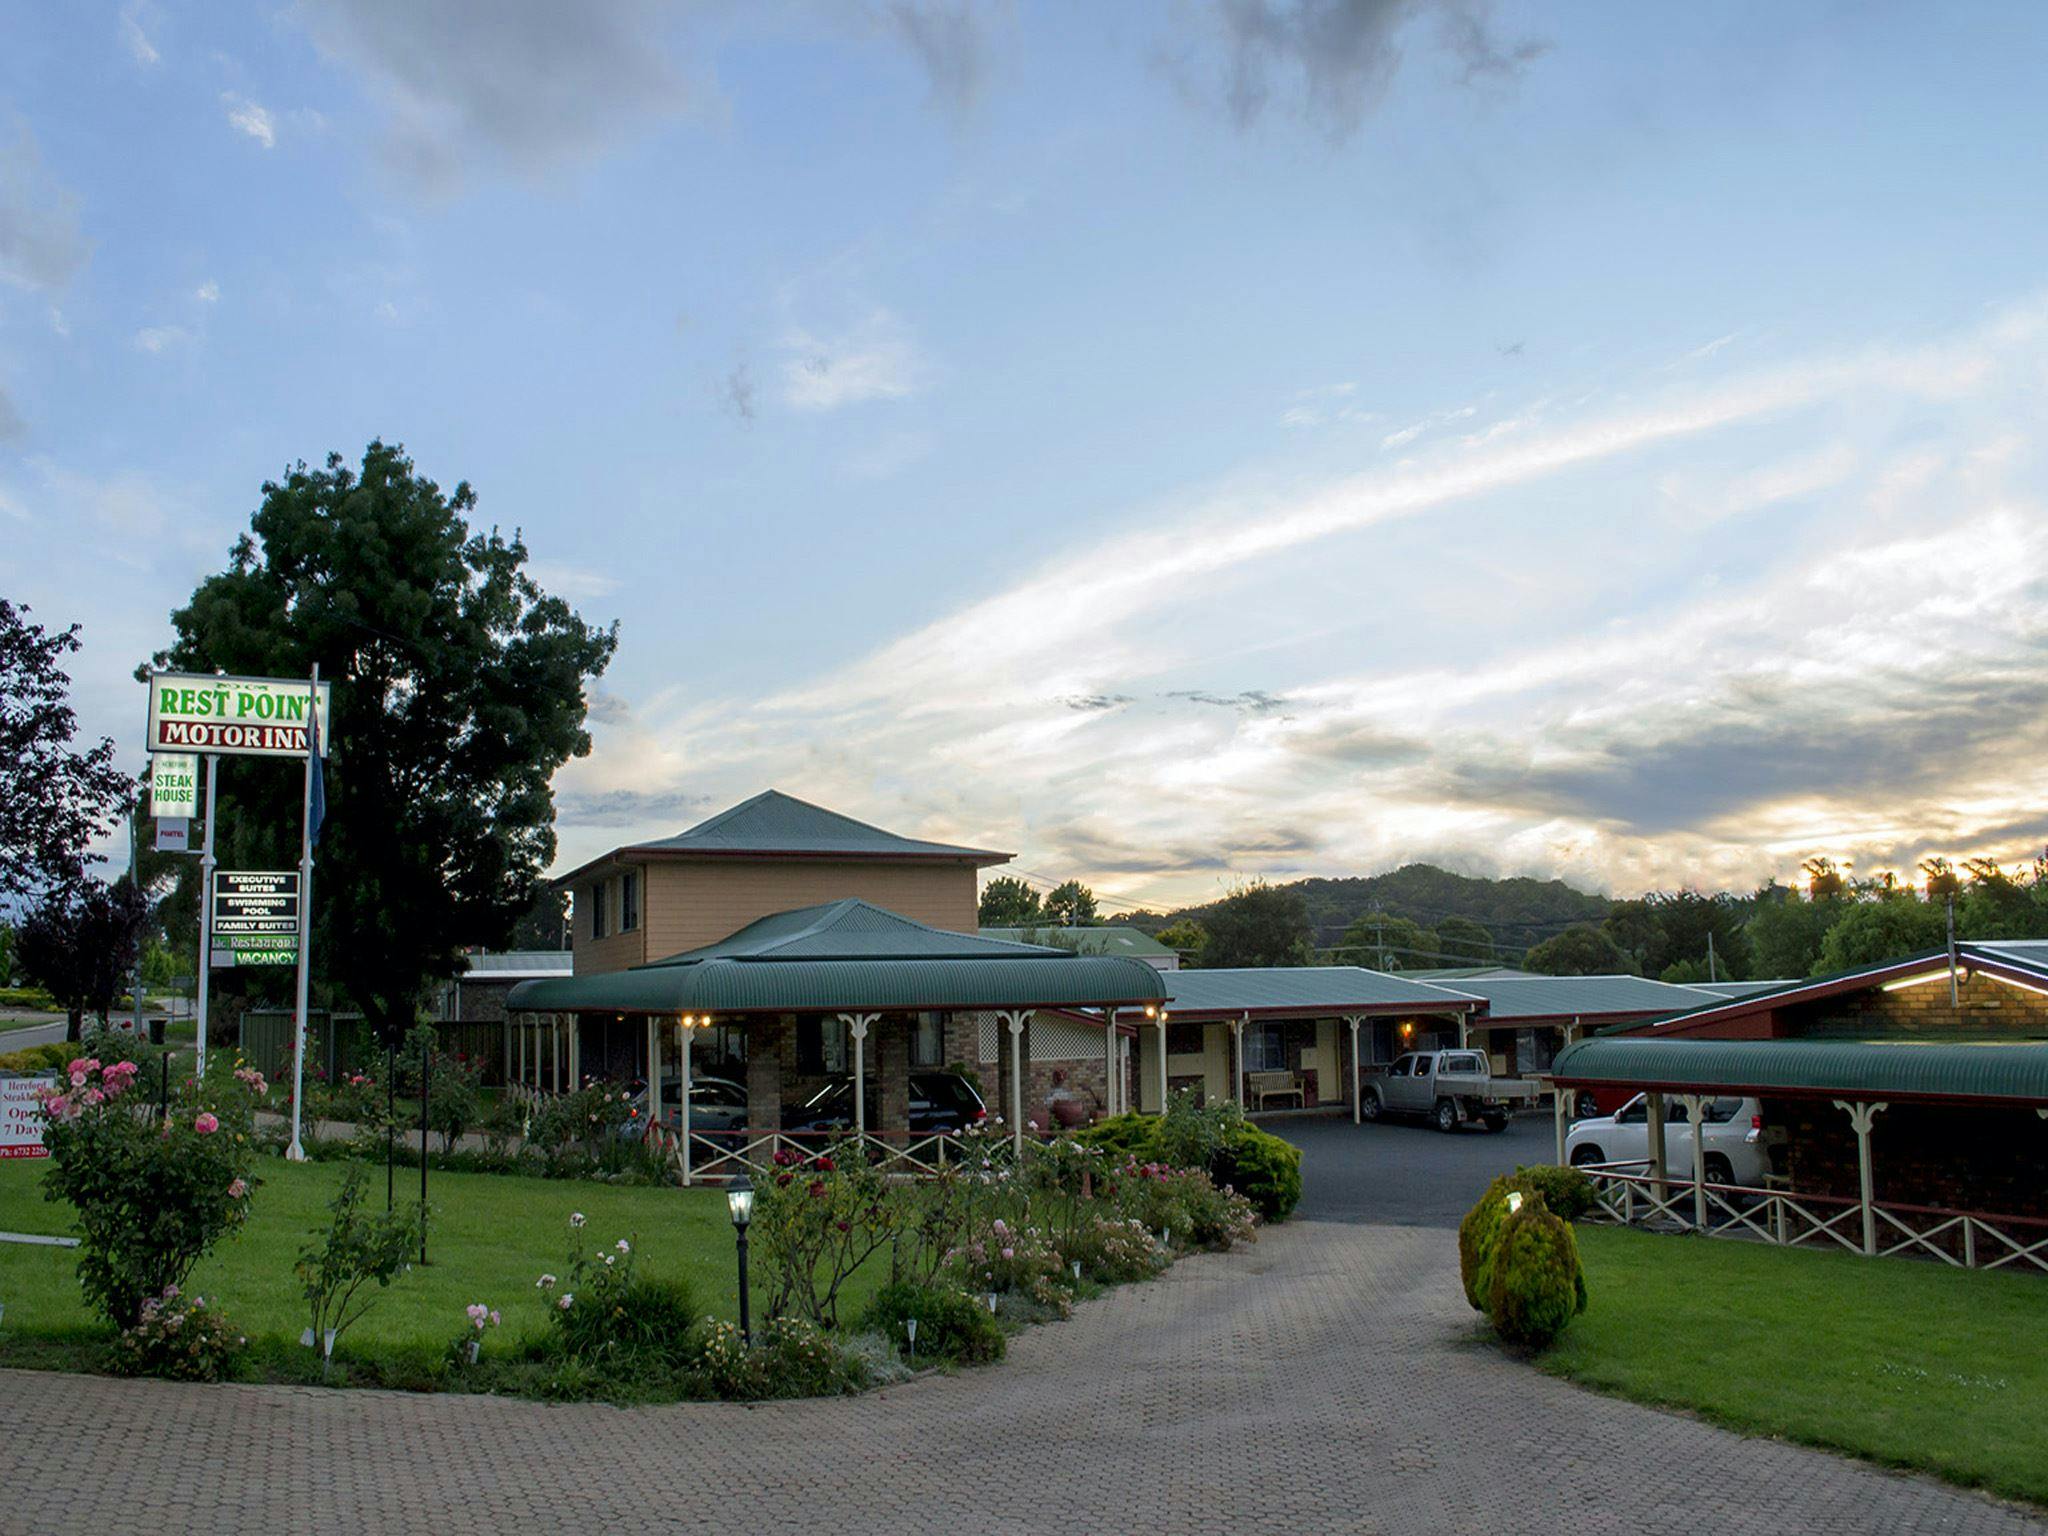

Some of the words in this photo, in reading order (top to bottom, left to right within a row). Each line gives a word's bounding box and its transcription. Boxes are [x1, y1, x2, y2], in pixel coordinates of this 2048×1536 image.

[159, 687, 231, 717] REST
[165, 722, 261, 747] MOTOR
[264, 727, 309, 750] INN
[155, 774, 193, 787] STEAK
[154, 789, 193, 802] HOUSE
[228, 875, 286, 884] EXECUTIVE
[238, 884, 276, 892] SUITES
[227, 898, 287, 907] SWIMMING
[242, 907, 272, 915] POOL
[217, 921, 257, 930] FAMILY
[258, 921, 295, 930] SUITES
[230, 935, 298, 949] Restaurant
[237, 952, 297, 965] VACANCY
[4, 1124, 12, 1136] 7
